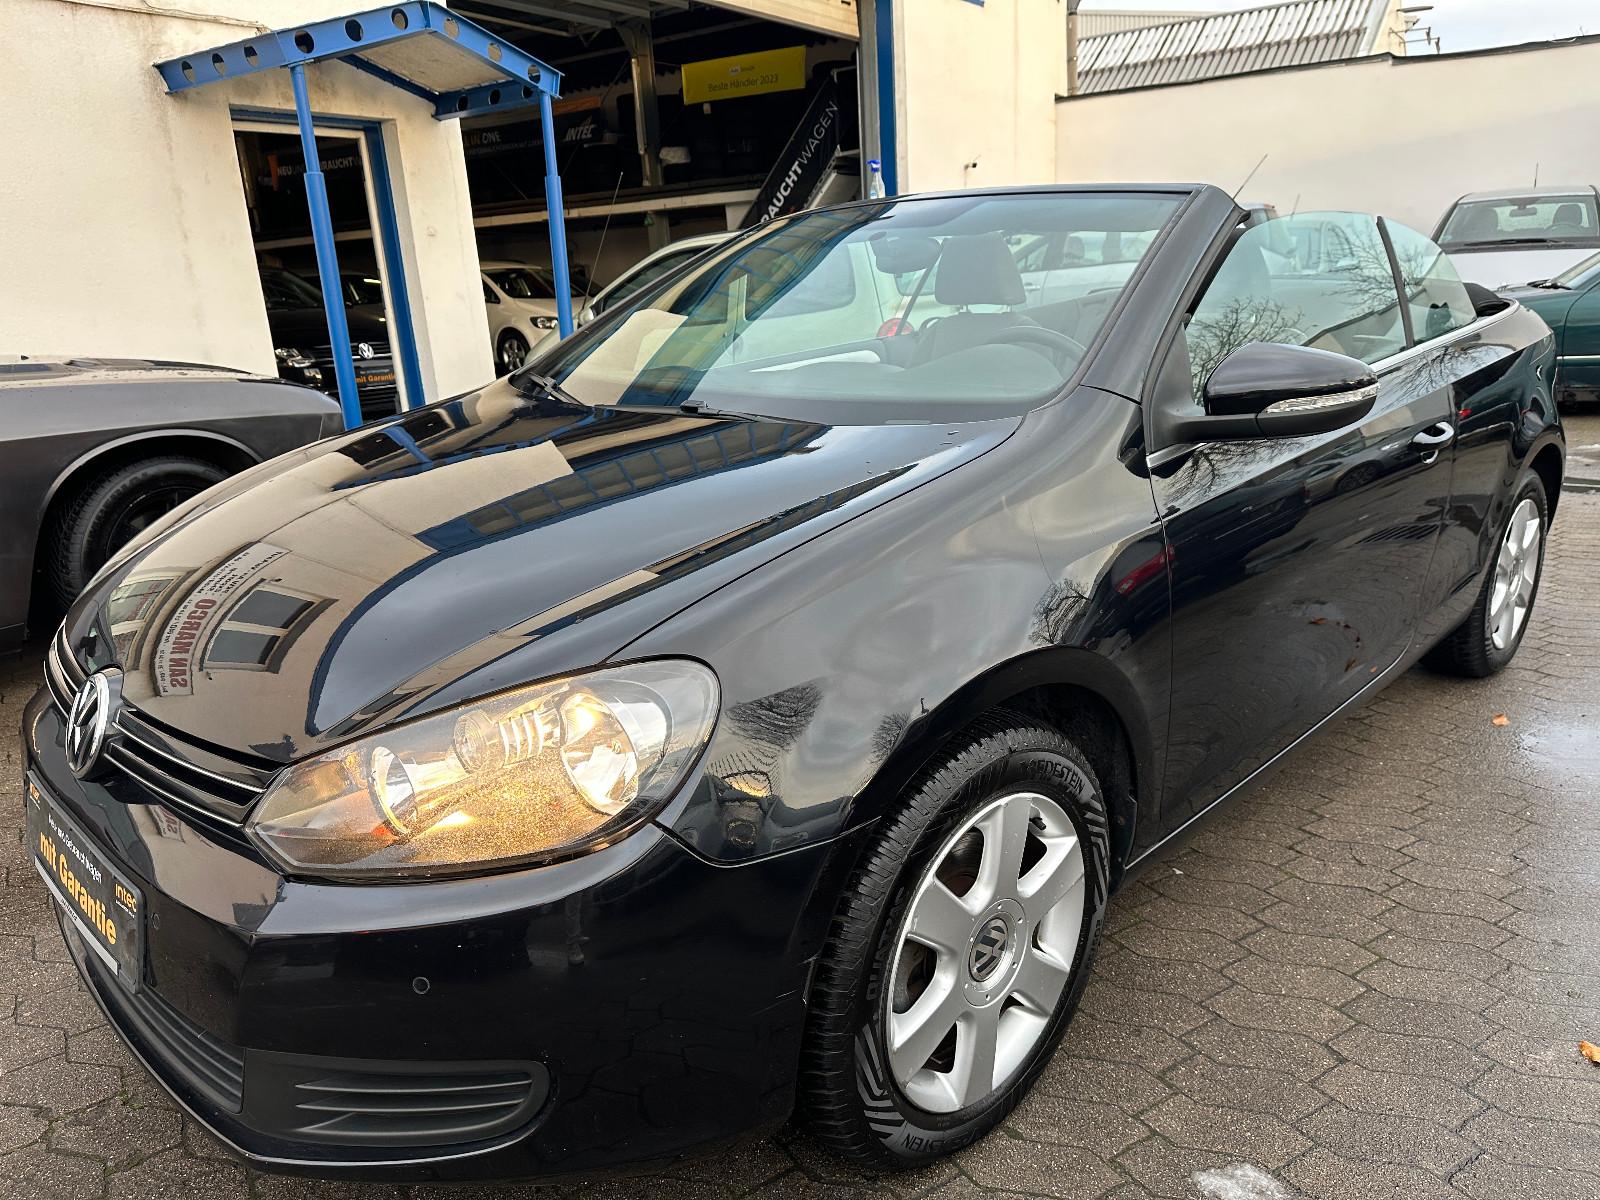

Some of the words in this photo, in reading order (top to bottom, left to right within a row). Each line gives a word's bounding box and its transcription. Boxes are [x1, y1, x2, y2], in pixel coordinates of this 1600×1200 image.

[707, 82, 729, 92] Beste
[730, 77, 758, 89] Händler
[759, 73, 778, 85] 2023
[481, 131, 501, 144] ONE
[563, 123, 597, 142] INTEC
[40, 831, 57, 872] mit
[59, 853, 117, 944] Garantie
[115, 883, 137, 912] intec
